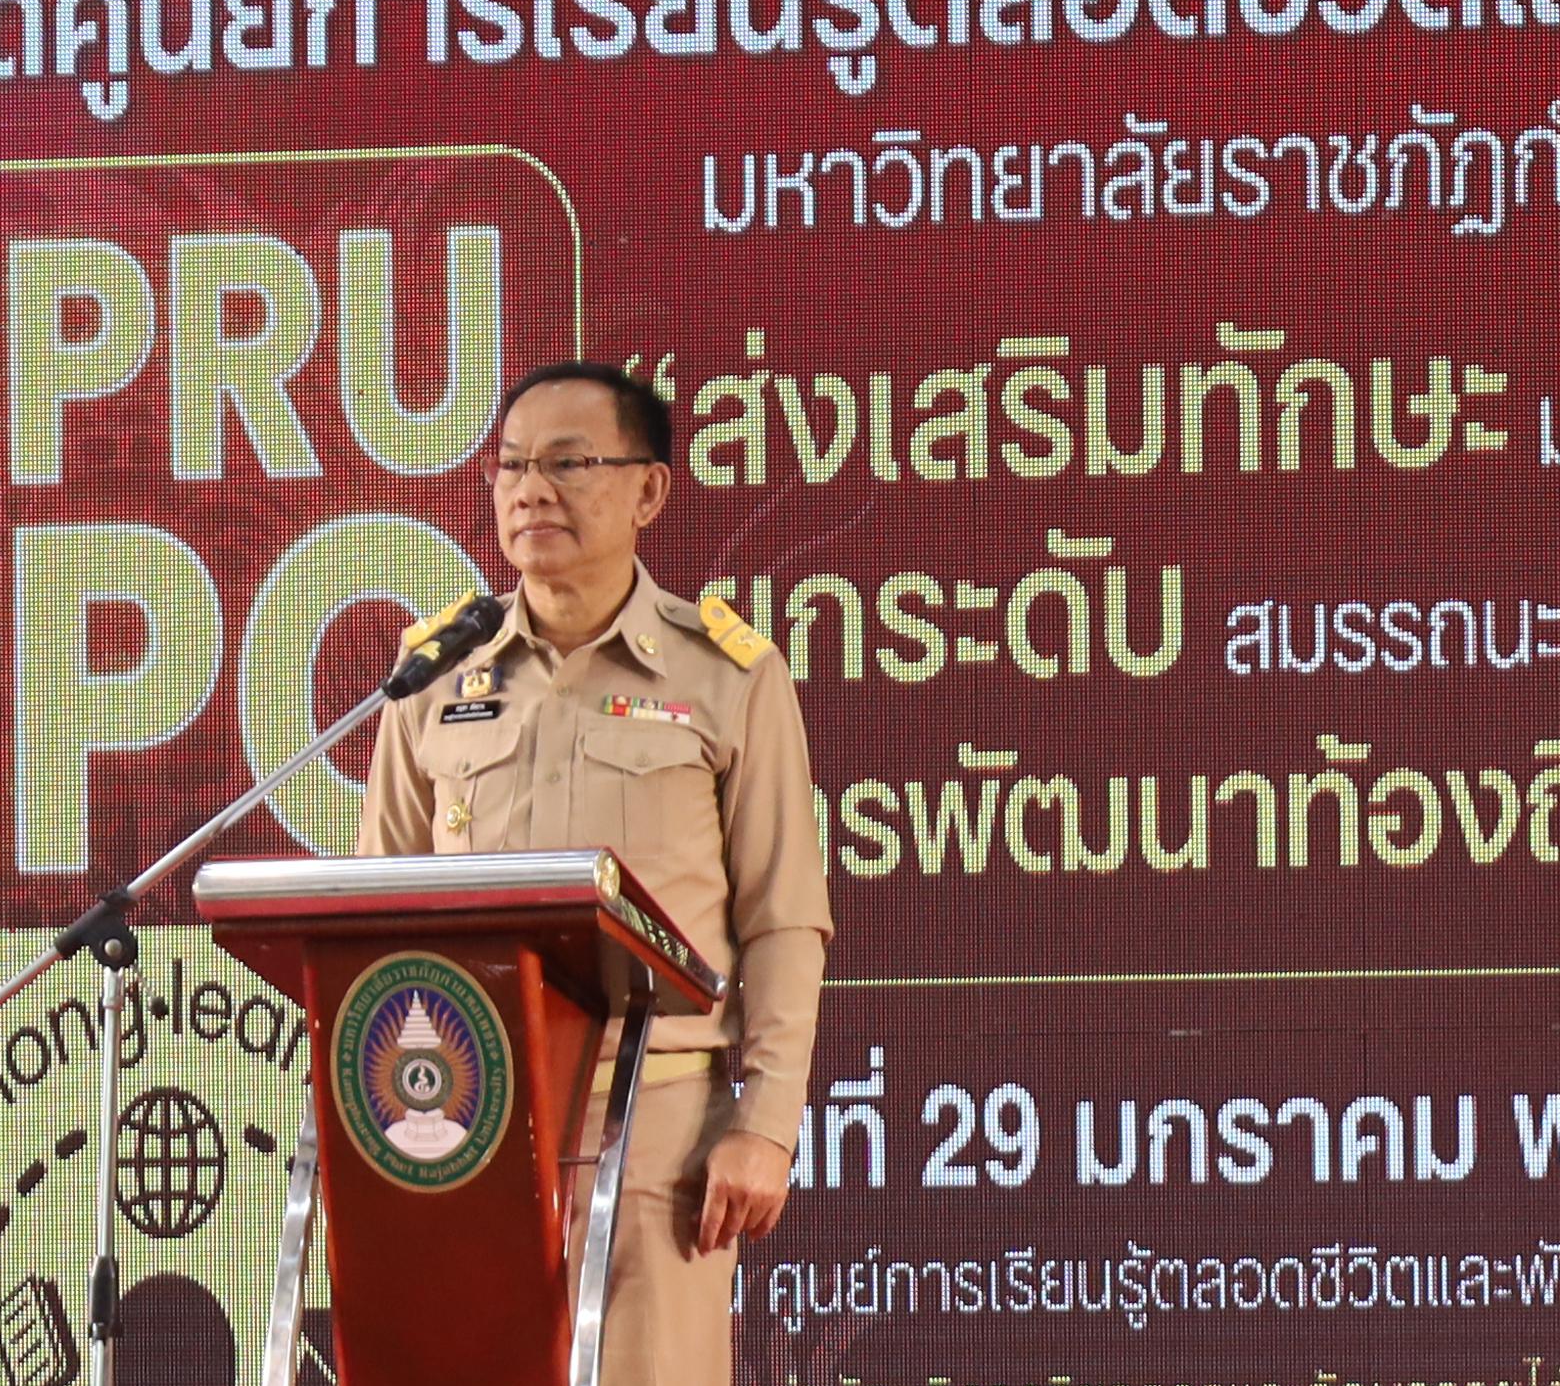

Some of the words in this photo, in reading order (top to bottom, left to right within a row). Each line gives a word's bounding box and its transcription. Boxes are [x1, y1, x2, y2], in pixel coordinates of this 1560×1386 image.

[173, 957, 310, 1079] lear
[922, 1083, 1040, 1188] 29
[1076, 1095, 1476, 1186] มกราคม
